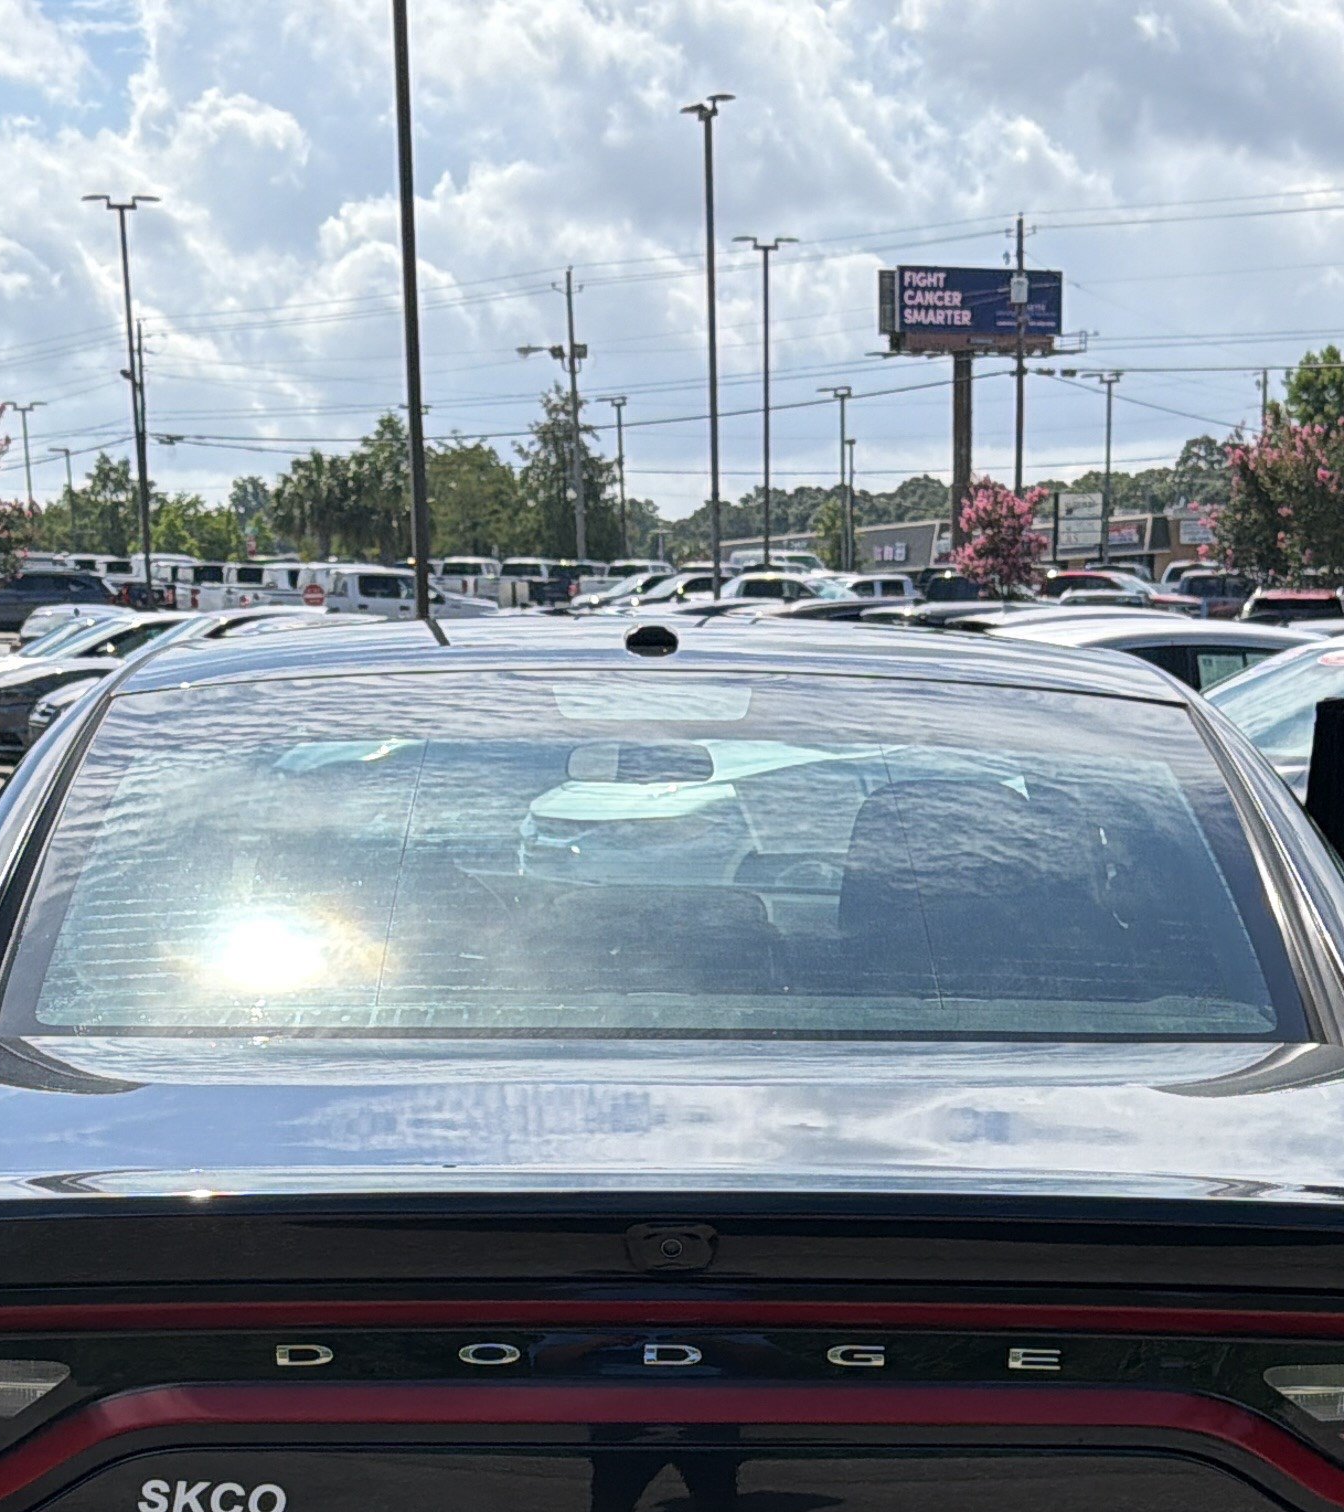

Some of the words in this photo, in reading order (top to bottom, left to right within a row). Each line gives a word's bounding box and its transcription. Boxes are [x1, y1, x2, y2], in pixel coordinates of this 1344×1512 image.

[904, 271, 946, 288] FIGHT
[904, 291, 962, 307] CANCER
[904, 309, 972, 326] SMARTER
[276, 1343, 1062, 1371] DODGE
